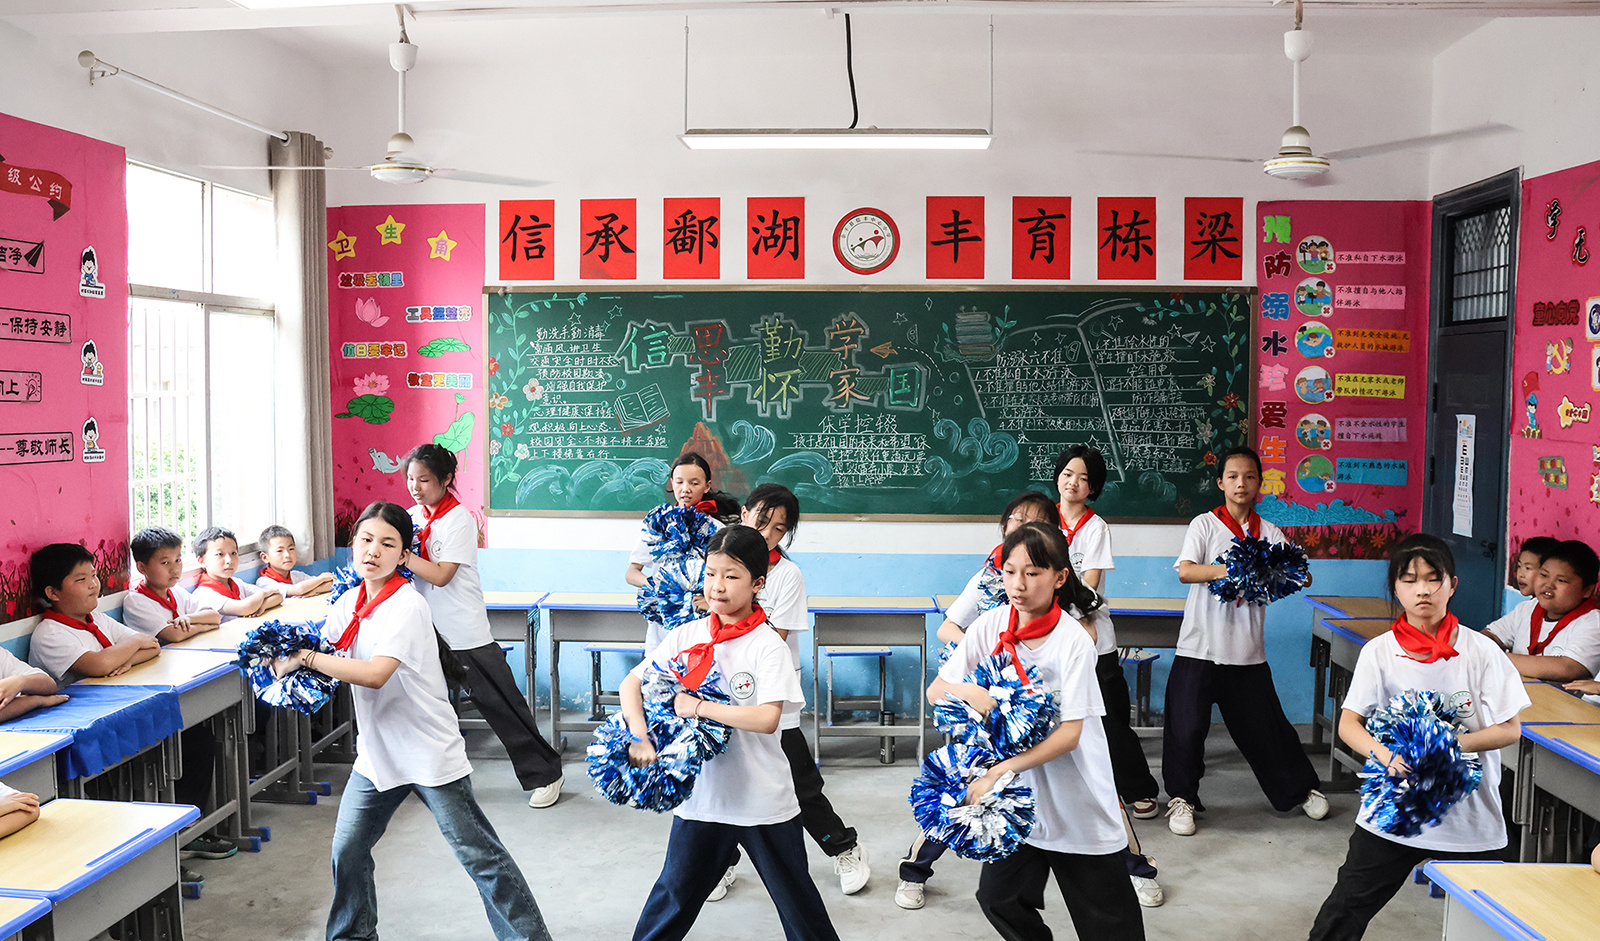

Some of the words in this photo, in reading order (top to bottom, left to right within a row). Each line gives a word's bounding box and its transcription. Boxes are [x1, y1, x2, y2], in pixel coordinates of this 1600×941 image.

[8, 167, 62, 200] 级公约
[336, 223, 449, 257] 卫生角
[931, 208, 1241, 264] 丰育栋梁
